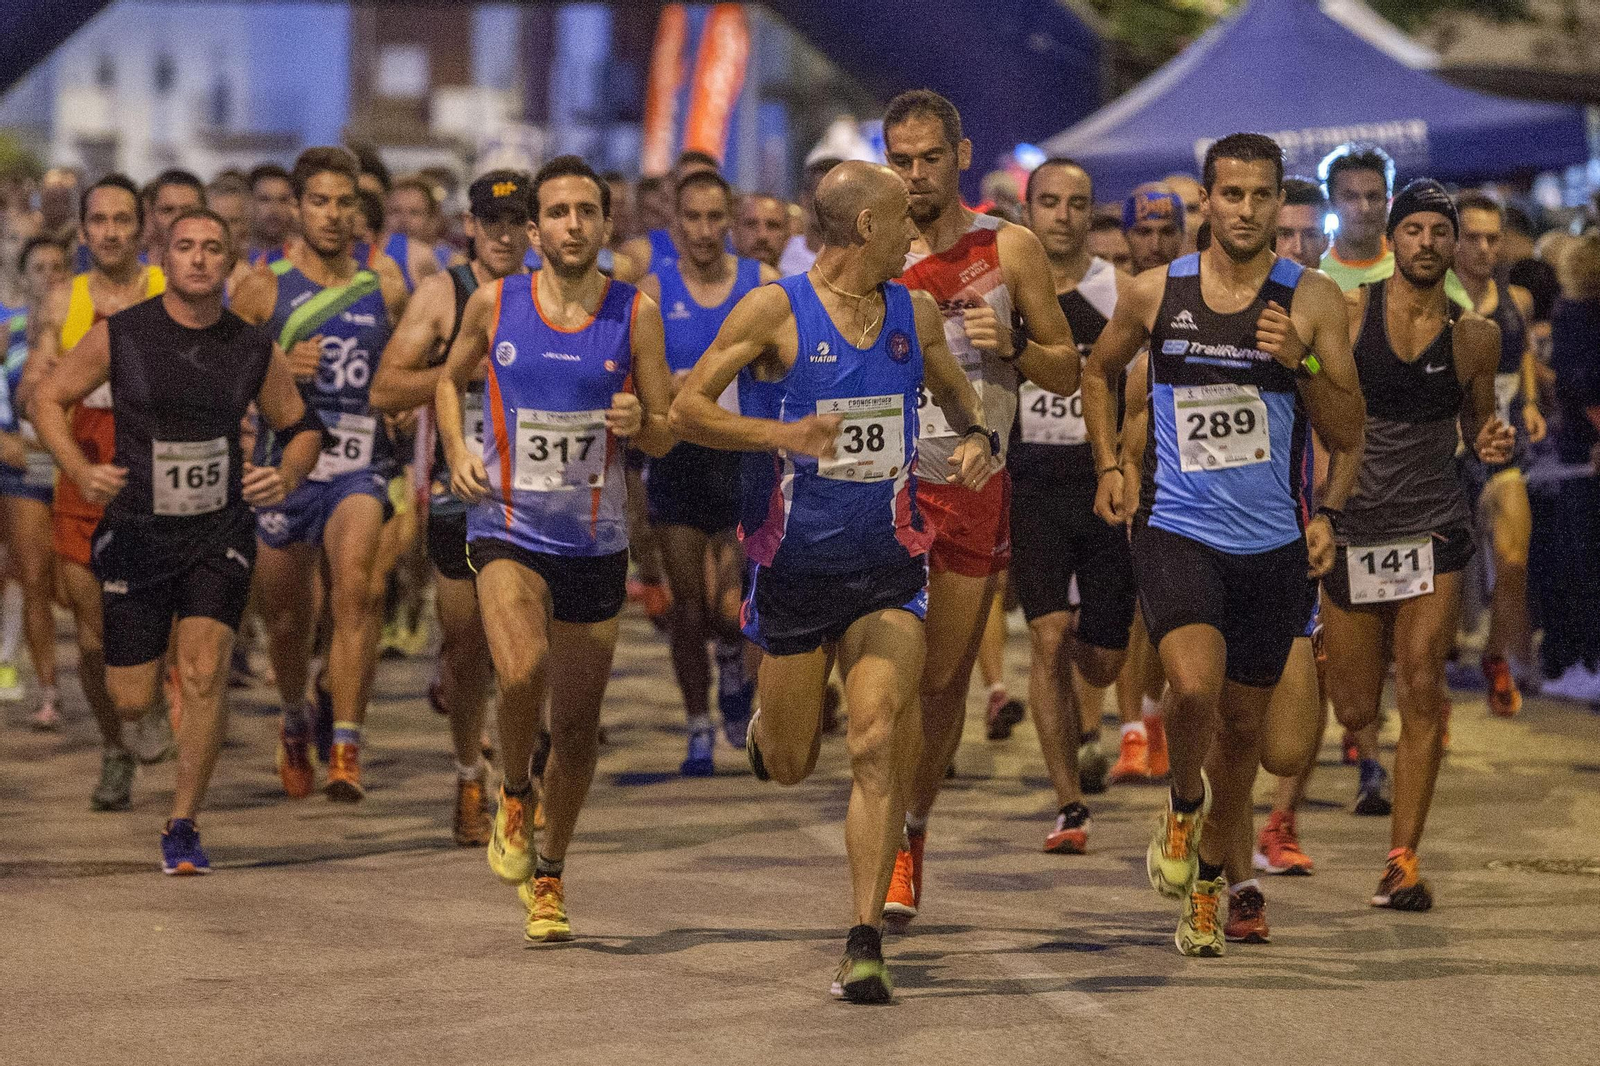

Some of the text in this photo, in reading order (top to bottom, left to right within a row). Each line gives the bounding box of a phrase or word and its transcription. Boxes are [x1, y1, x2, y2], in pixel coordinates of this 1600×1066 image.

[809, 355, 838, 363] VIATOR
[1031, 394, 1083, 418] 450
[1187, 408, 1256, 441] 289
[528, 435, 596, 463] 317
[843, 423, 885, 454] 38
[166, 462, 221, 489] 165
[1360, 548, 1419, 575] 141
